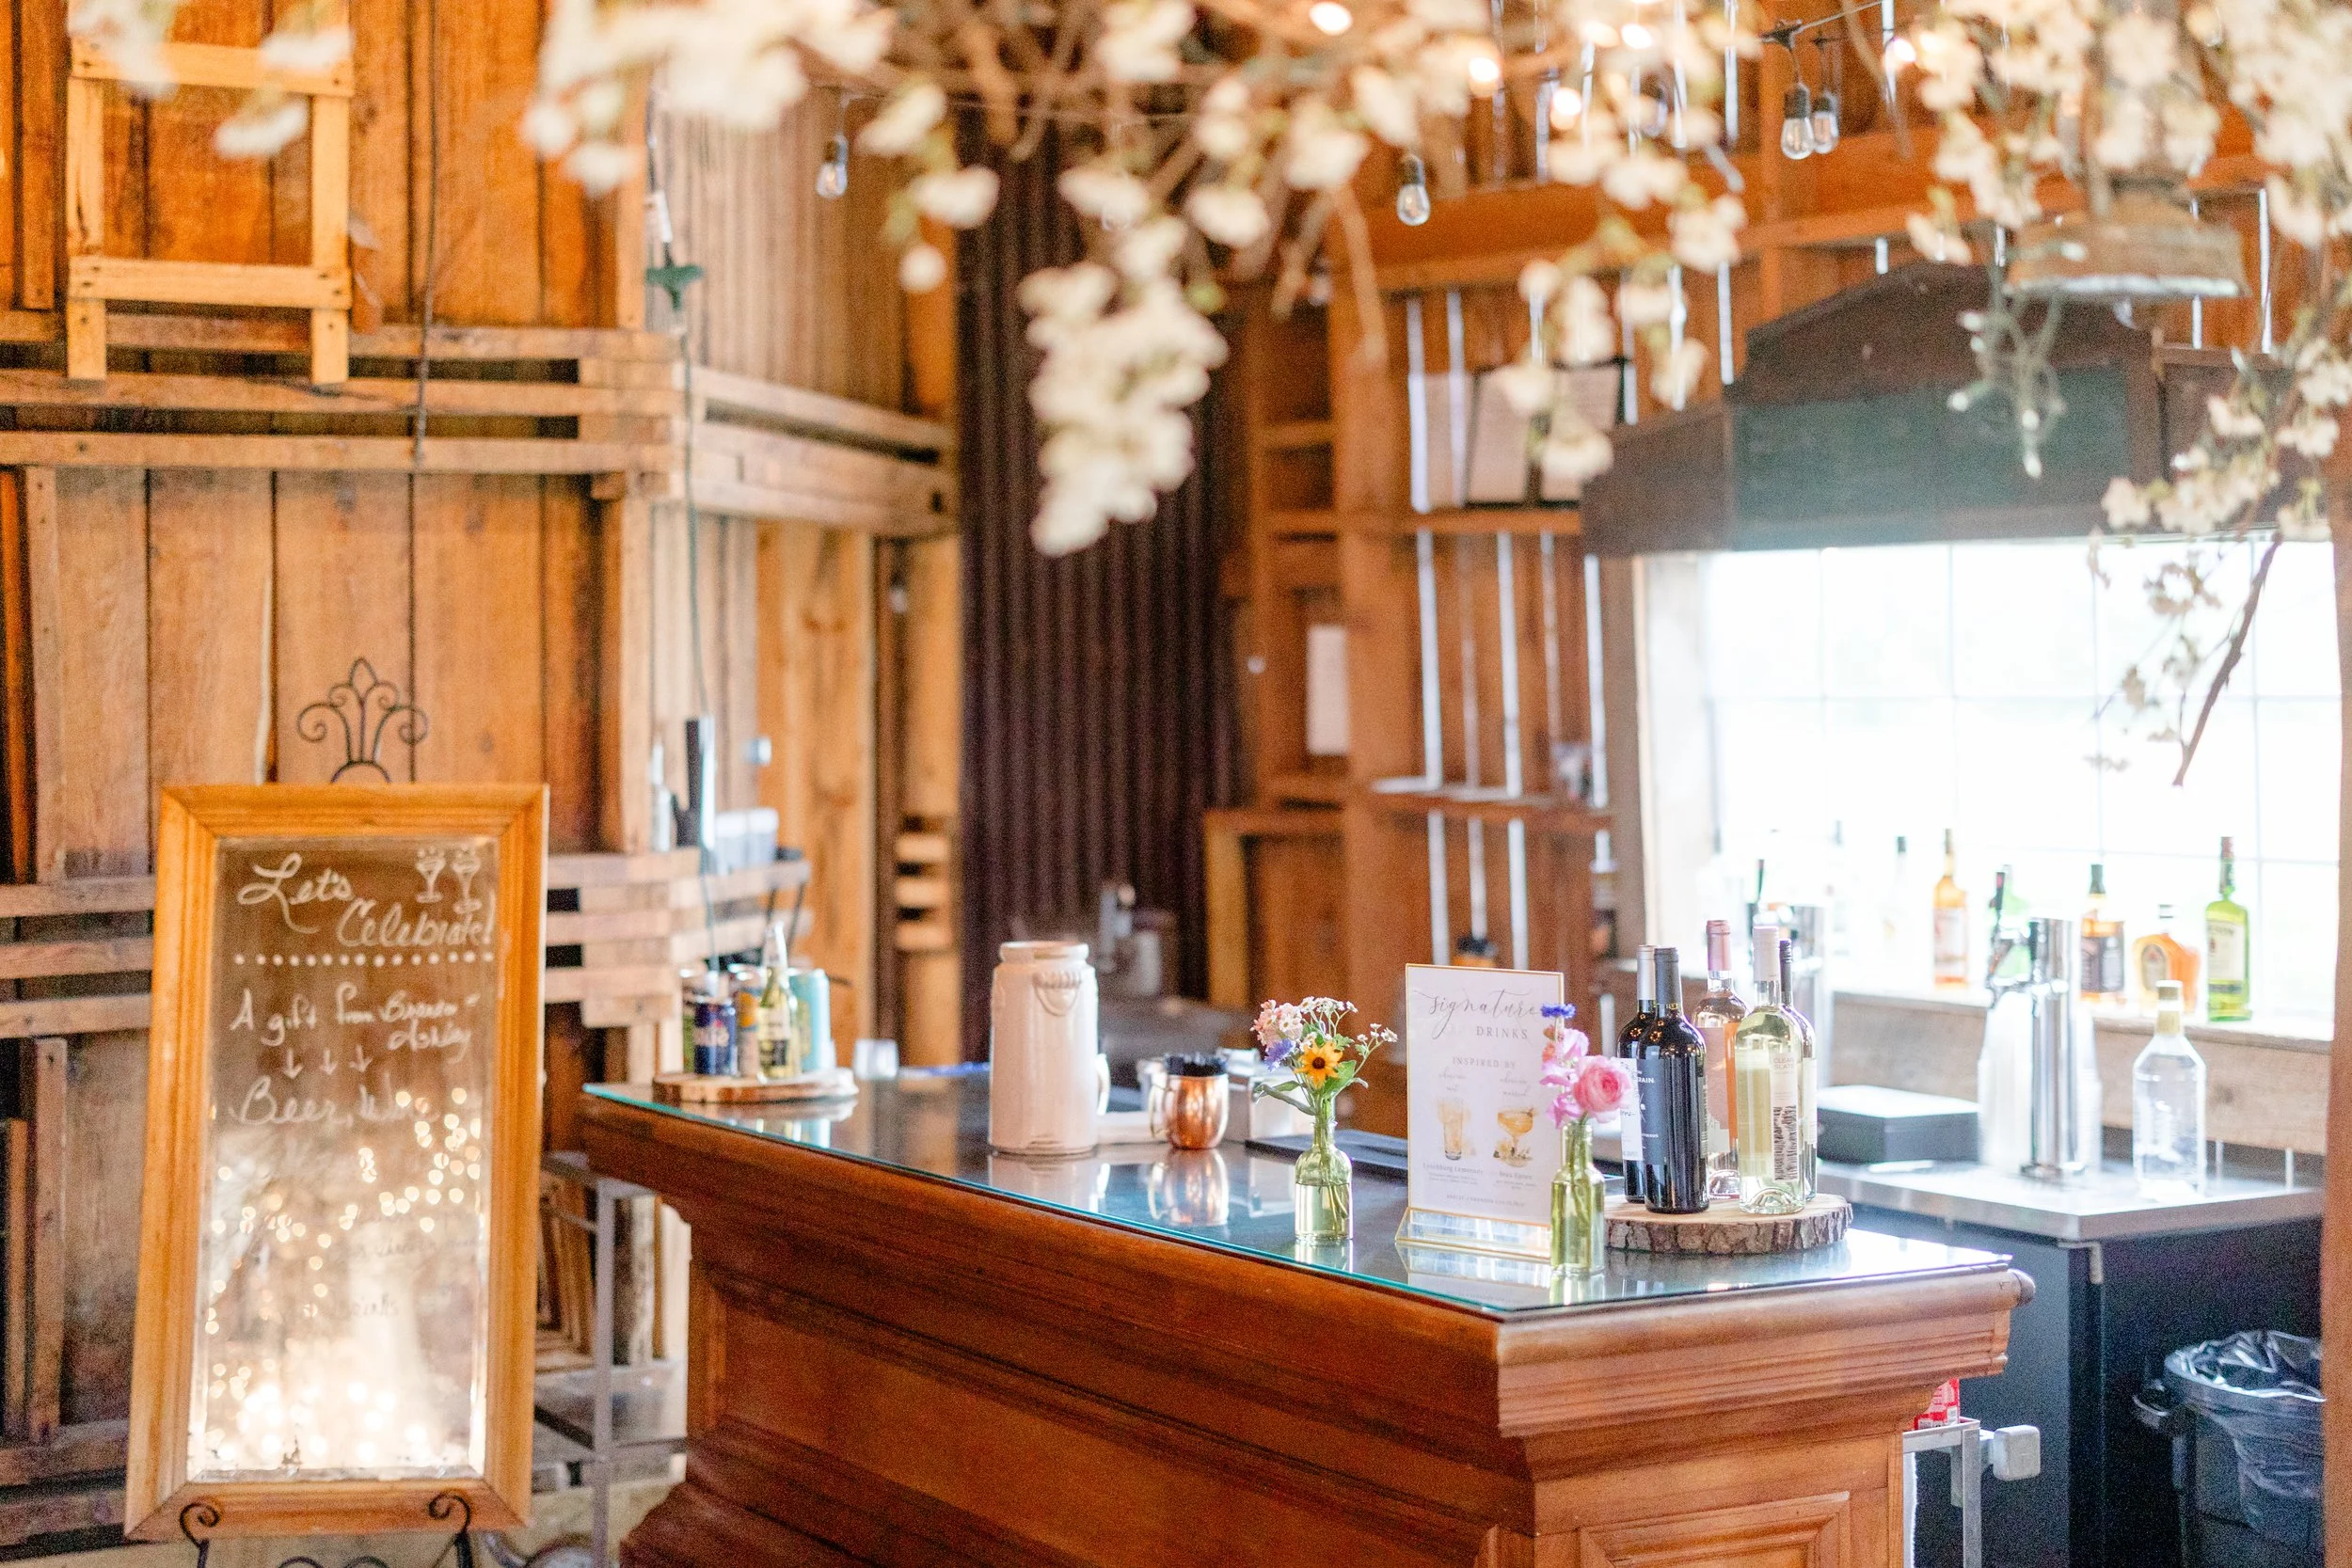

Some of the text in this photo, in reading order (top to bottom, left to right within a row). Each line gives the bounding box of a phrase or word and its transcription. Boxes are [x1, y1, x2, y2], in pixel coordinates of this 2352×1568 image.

[236, 851, 354, 934] Let's
[336, 889, 497, 948] Celebrate!
[230, 989, 254, 1032] A
[261, 994, 318, 1046] gift
[335, 981, 375, 1025] from
[1413, 988, 1542, 1040] signature
[1475, 1025, 1529, 1040] DRINKS
[1452, 1056, 1517, 1069] INSPIRED BY
